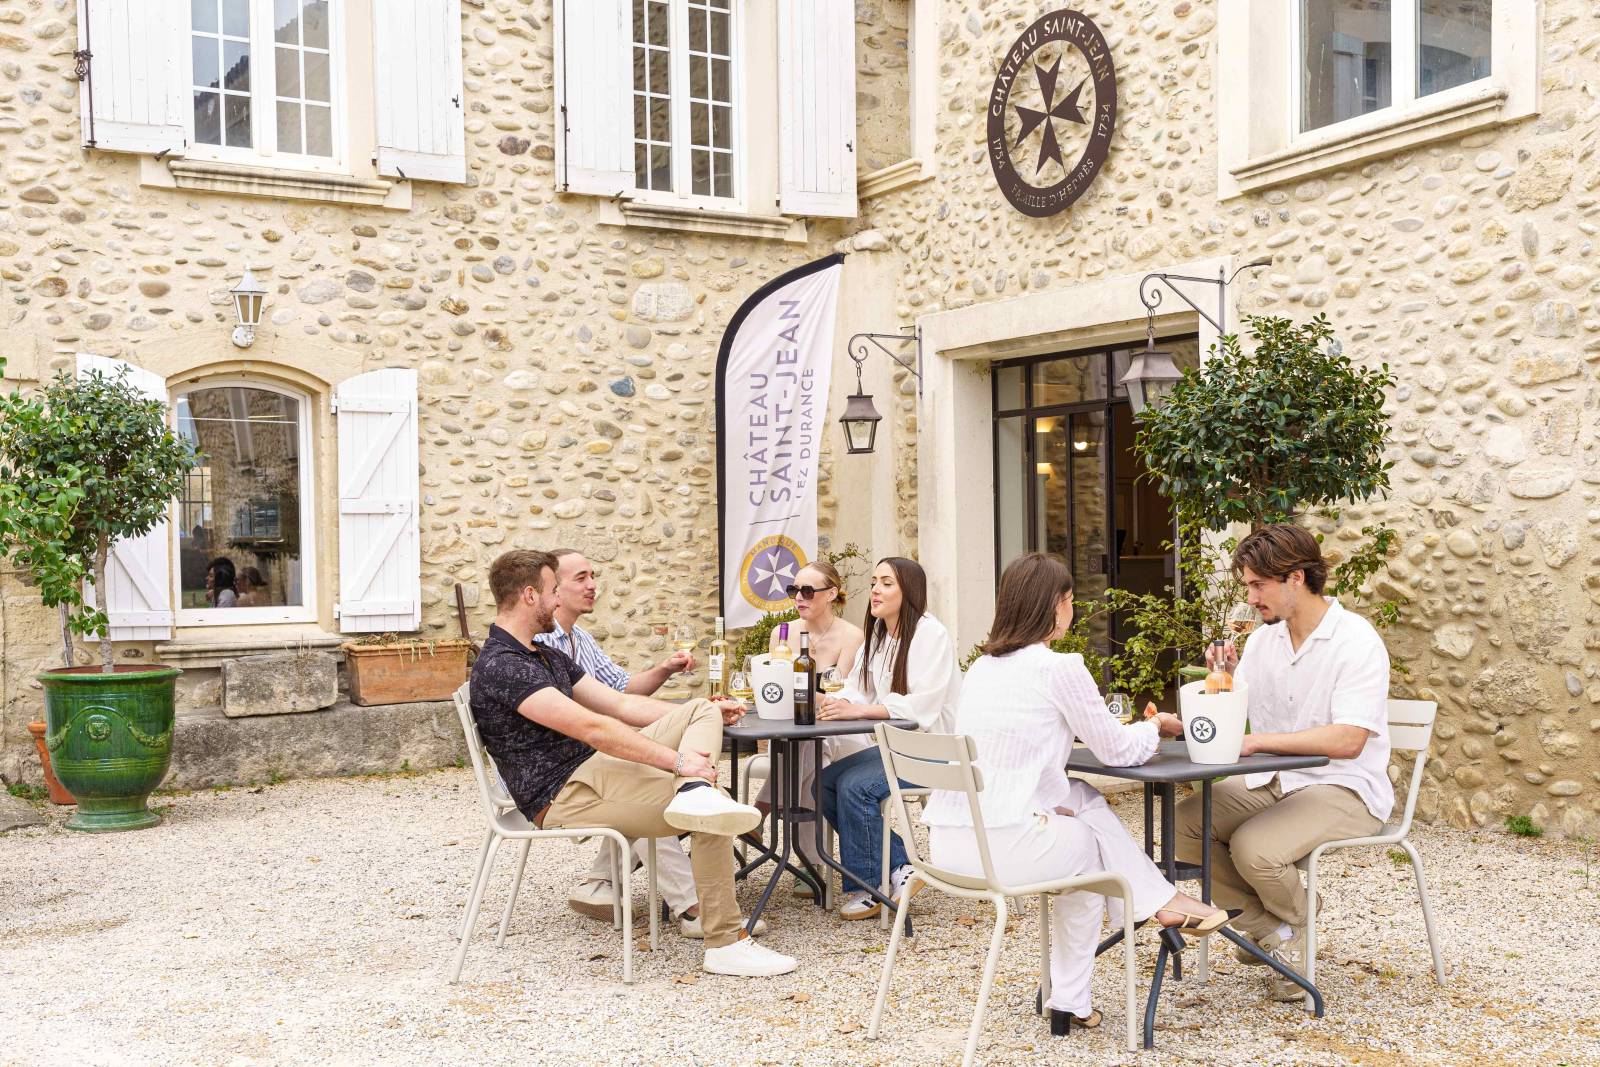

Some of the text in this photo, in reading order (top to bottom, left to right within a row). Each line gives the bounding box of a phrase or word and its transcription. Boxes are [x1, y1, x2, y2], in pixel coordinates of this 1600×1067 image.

[993, 17, 1110, 117] CHÂTEAU SAINT-JEAN
[993, 138, 1006, 169] 1754
[1097, 103, 1111, 138] 1754
[743, 373, 768, 507] CHÂTEAU
[770, 300, 801, 503] SAINT-JEAN
[799, 368, 814, 460] DURANCE
